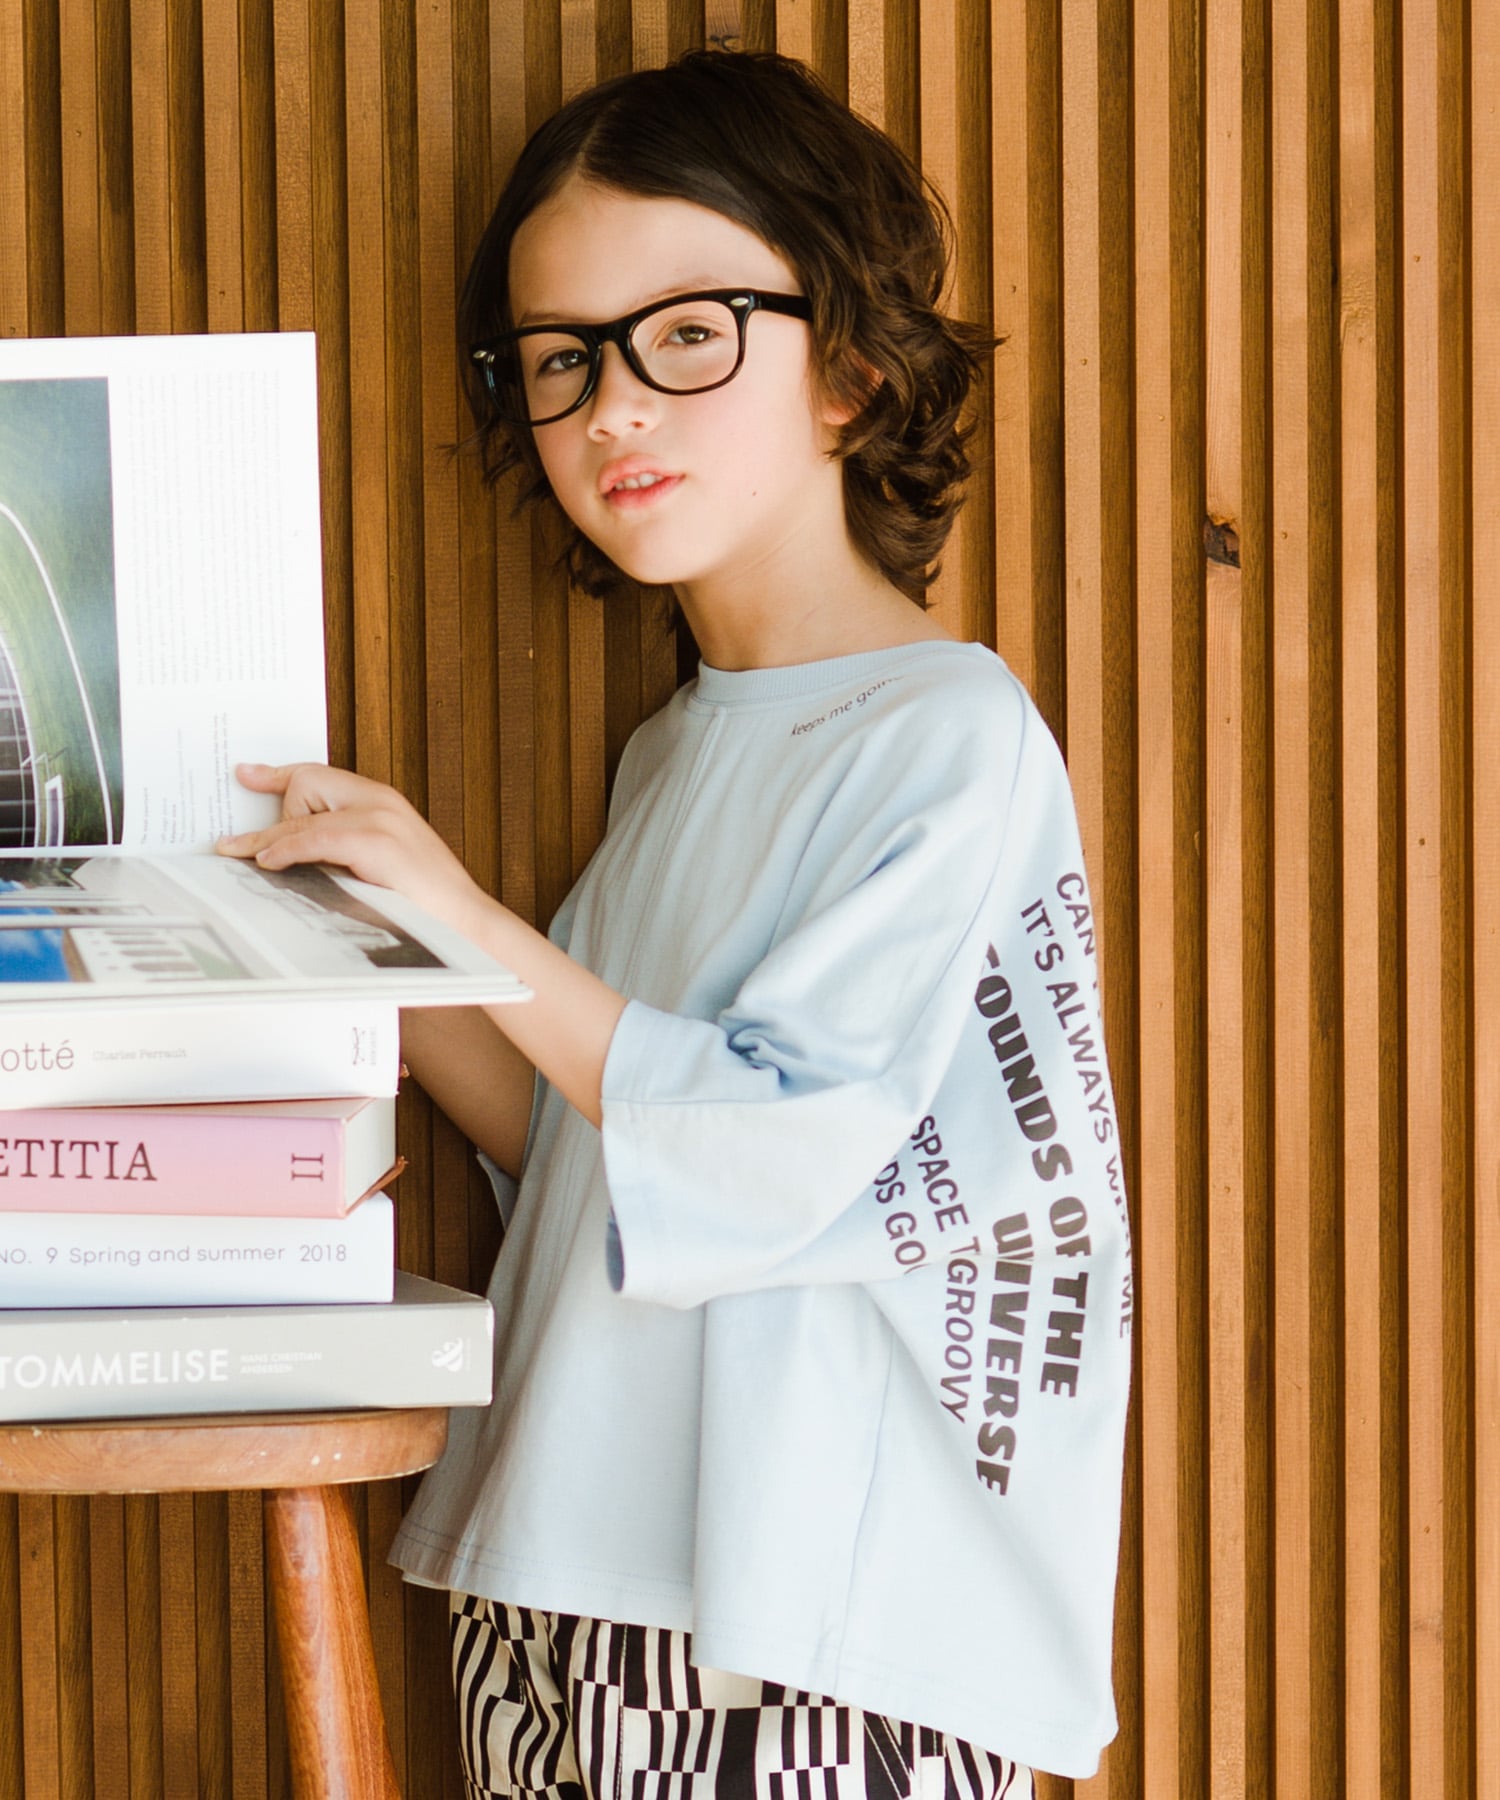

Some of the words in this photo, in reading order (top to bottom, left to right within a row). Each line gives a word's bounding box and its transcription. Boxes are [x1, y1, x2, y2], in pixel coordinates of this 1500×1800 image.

[829, 700, 853, 719] me
[856, 675, 904, 706] goi
[0, 1039, 75, 1072] otté
[1020, 898, 1064, 972] IT'S
[1046, 981, 1114, 1144] ALWAYS
[910, 1115, 970, 1232] SPACE
[974, 941, 1074, 1182] OUNDS
[1039, 1271, 1089, 1398] THE
[46, 1246, 58, 1265] 9
[69, 1245, 142, 1268] Spring
[147, 1244, 190, 1263] and
[197, 1247, 286, 1263] summer
[299, 1243, 347, 1263] 2018
[0, 1348, 229, 1390] TOMMELISE
[940, 1257, 979, 1424] GROOVY
[975, 1211, 1035, 1496] UIVERSE
